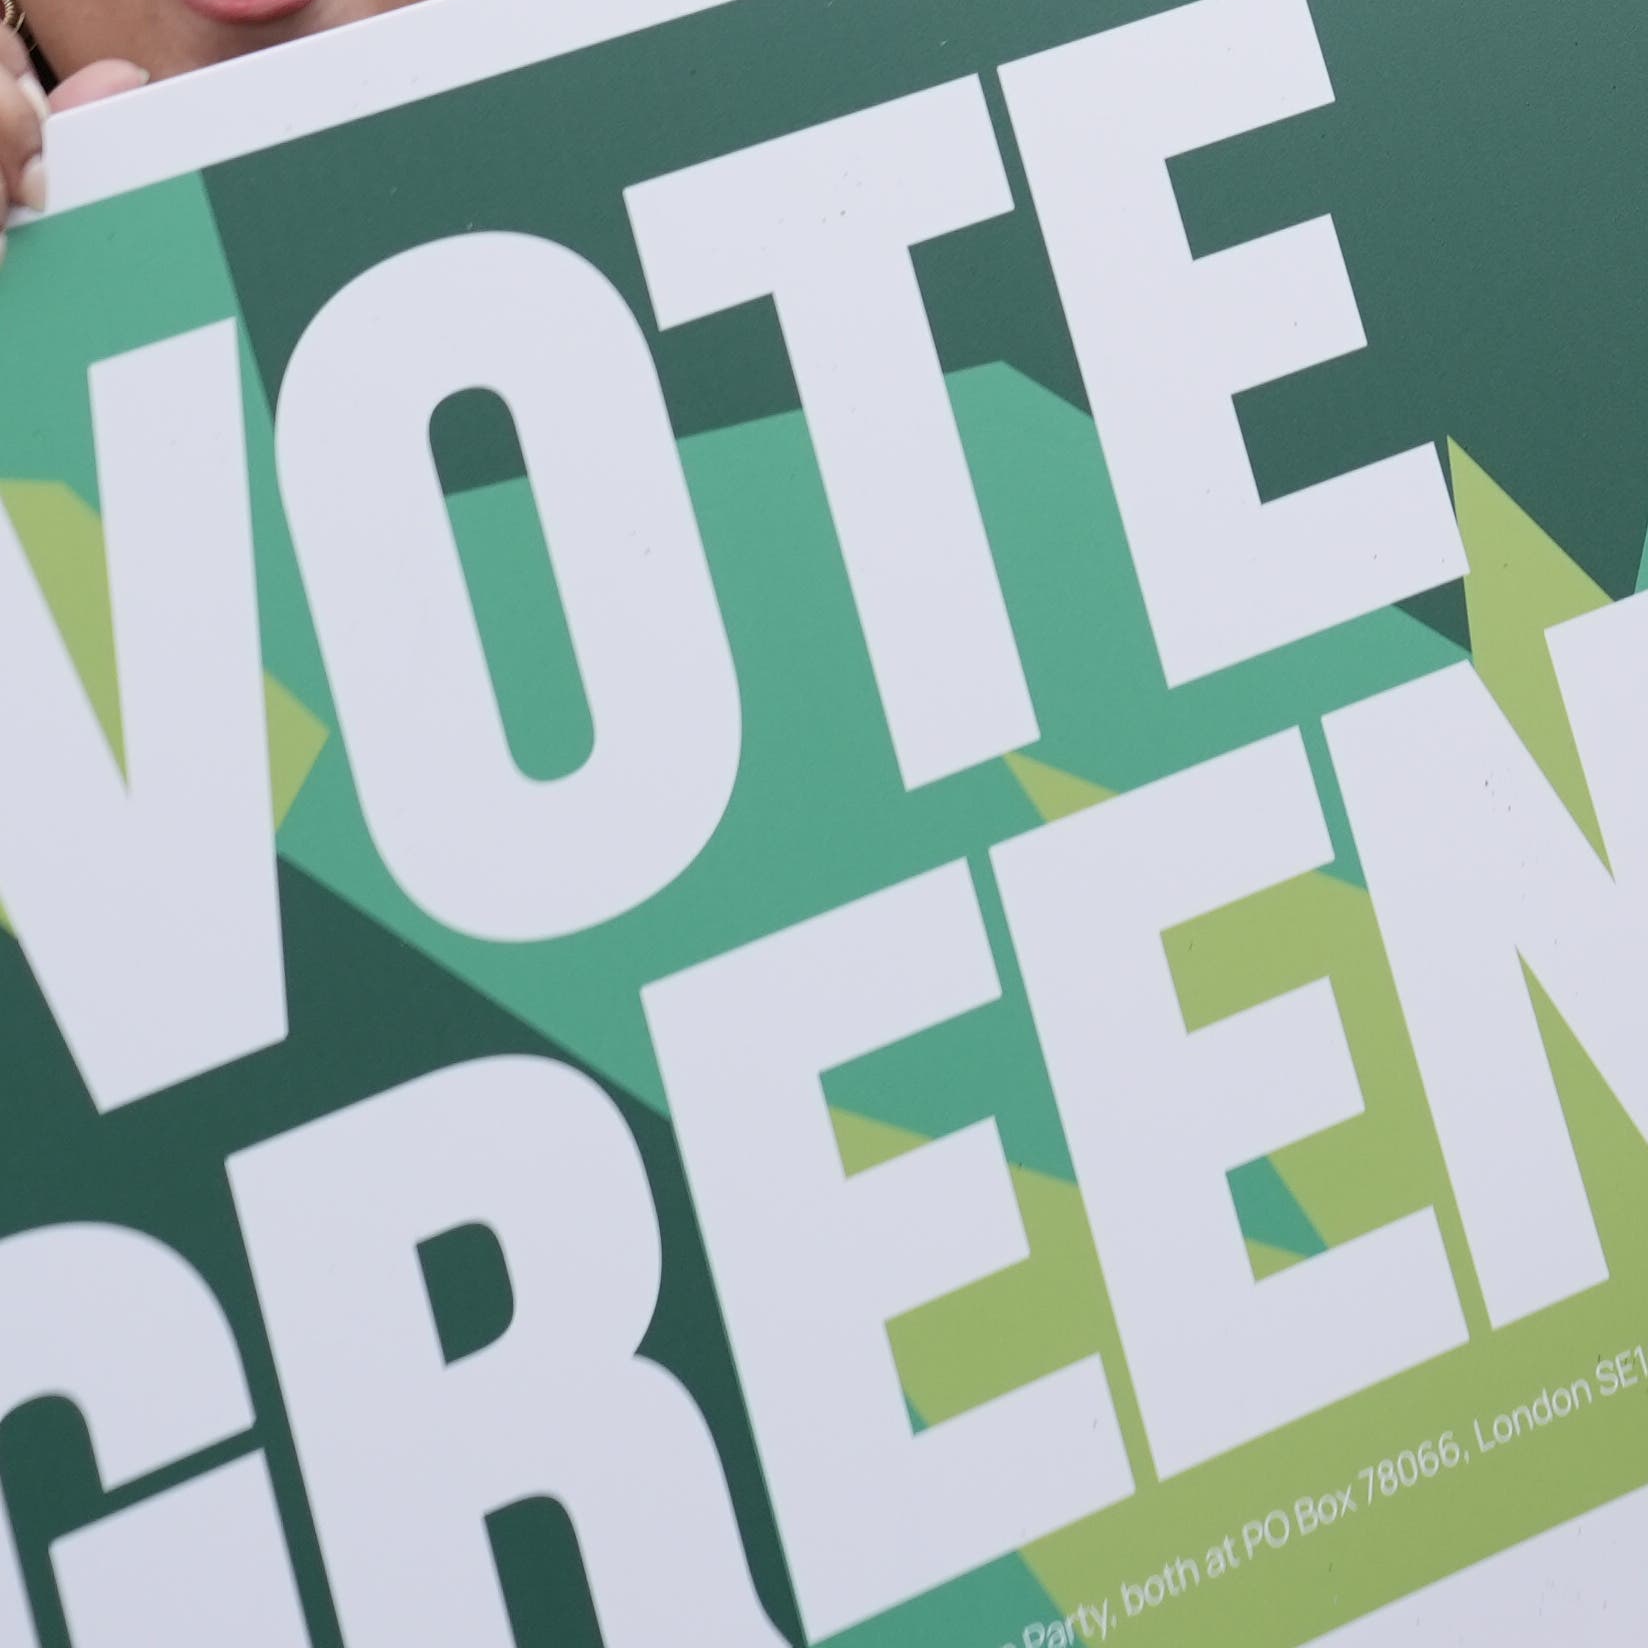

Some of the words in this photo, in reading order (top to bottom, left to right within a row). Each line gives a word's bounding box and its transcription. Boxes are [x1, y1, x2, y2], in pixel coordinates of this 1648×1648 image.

[1022, 1598, 1118, 1648] Party,
[1121, 1556, 1201, 1616] both
[1205, 1535, 1240, 1578] at
[1242, 1509, 1290, 1560] PO
[1294, 1483, 1357, 1536] Box
[1358, 1430, 1470, 1506] 78066,
[1473, 1379, 1593, 1453] London
